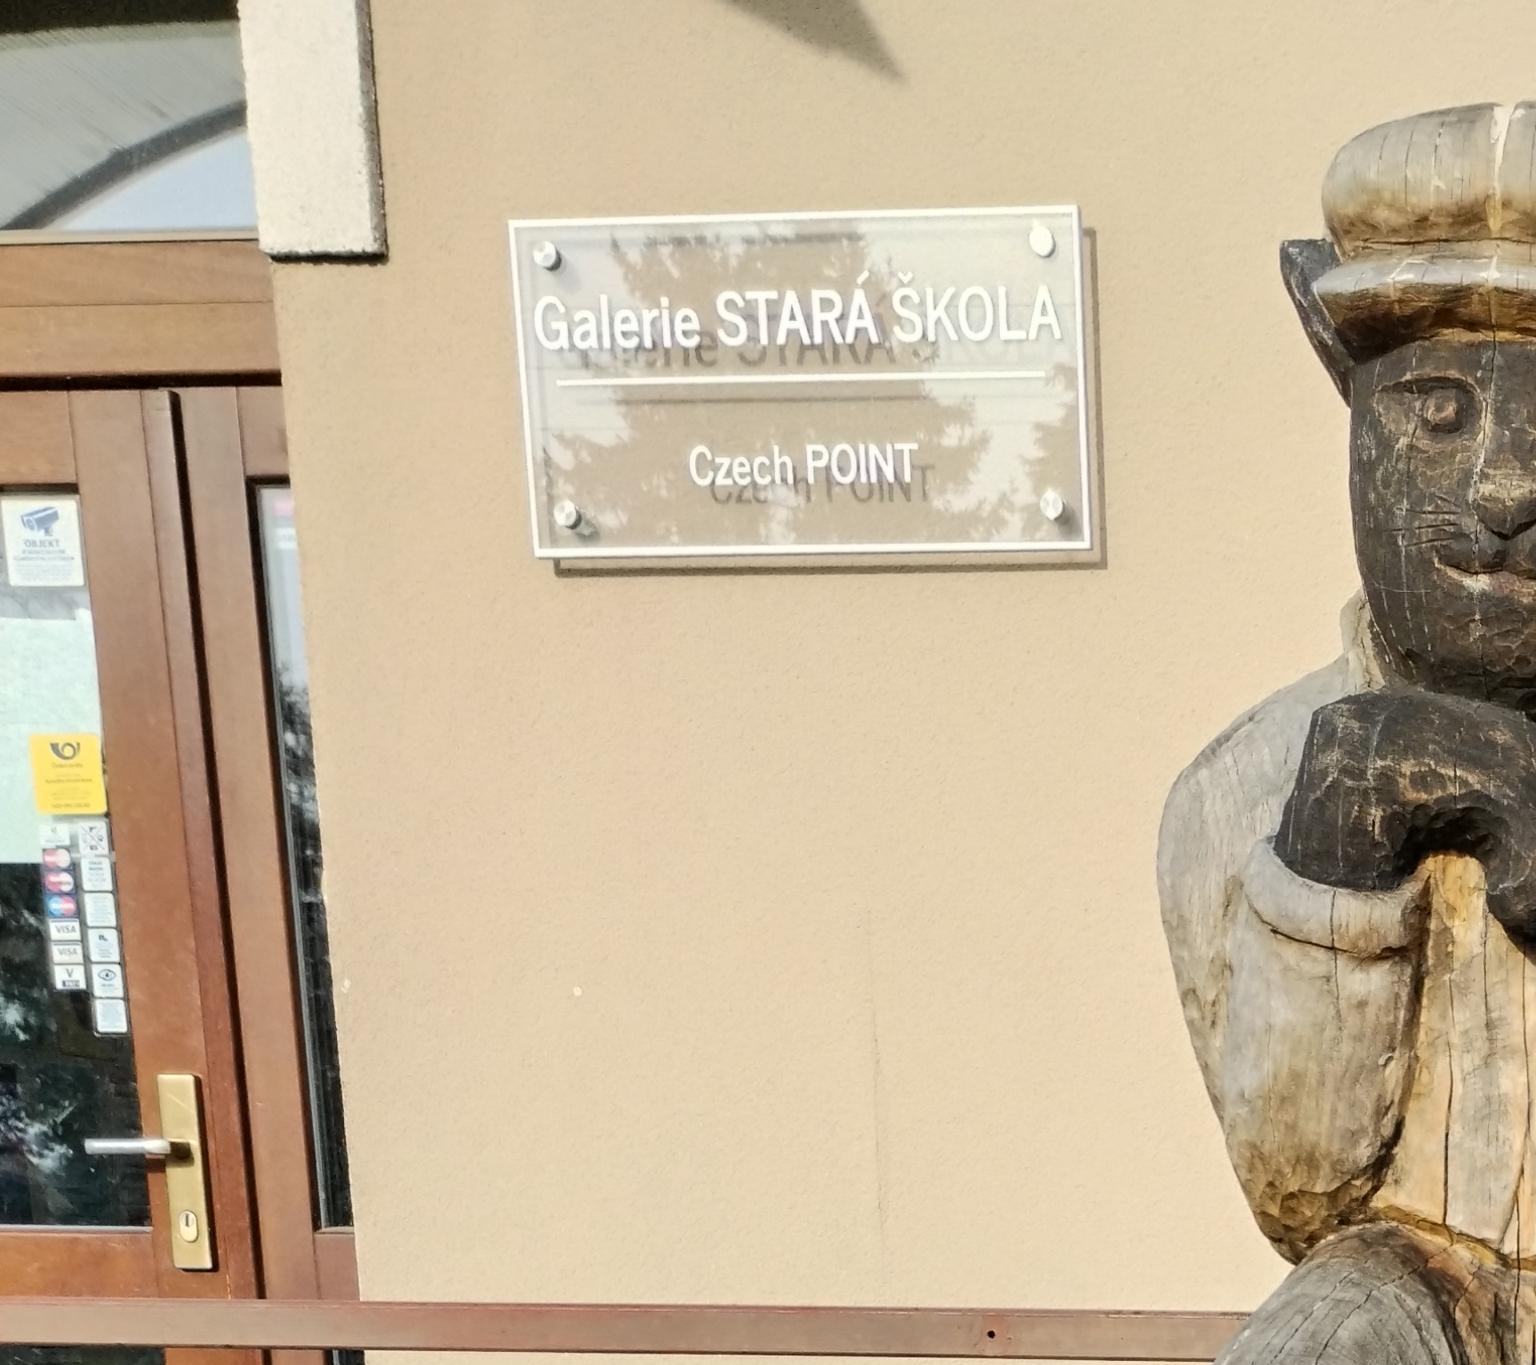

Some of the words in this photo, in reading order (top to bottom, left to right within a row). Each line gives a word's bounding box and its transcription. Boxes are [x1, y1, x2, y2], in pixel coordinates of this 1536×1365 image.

[534, 295, 700, 351] Galerie
[715, 270, 879, 346] STARÁ
[891, 271, 1063, 343] ŠKOLA
[689, 445, 794, 488] Czech
[806, 443, 918, 485] POINT
